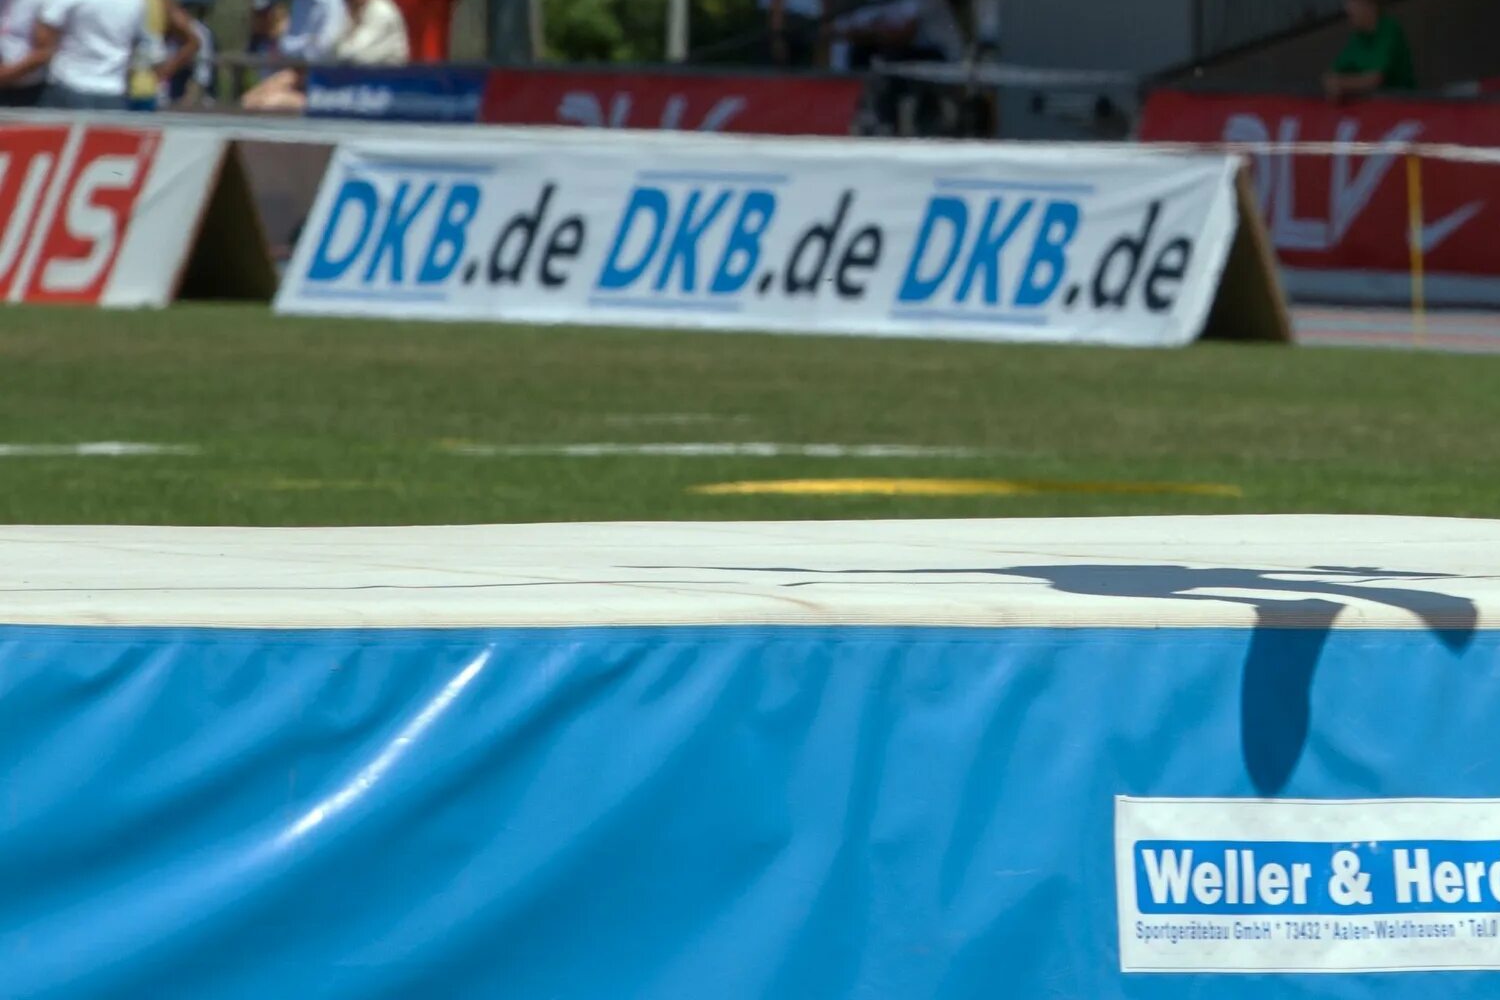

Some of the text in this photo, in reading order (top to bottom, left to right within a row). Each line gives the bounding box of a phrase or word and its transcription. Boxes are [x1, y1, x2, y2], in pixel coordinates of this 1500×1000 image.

[307, 179, 1195, 311] DKB.de DKB.de DKB.de
[1141, 849, 1312, 905] Weller
[1328, 850, 1373, 905] &
[1234, 920, 1272, 940] GmbH
[1285, 920, 1322, 940] 73432
